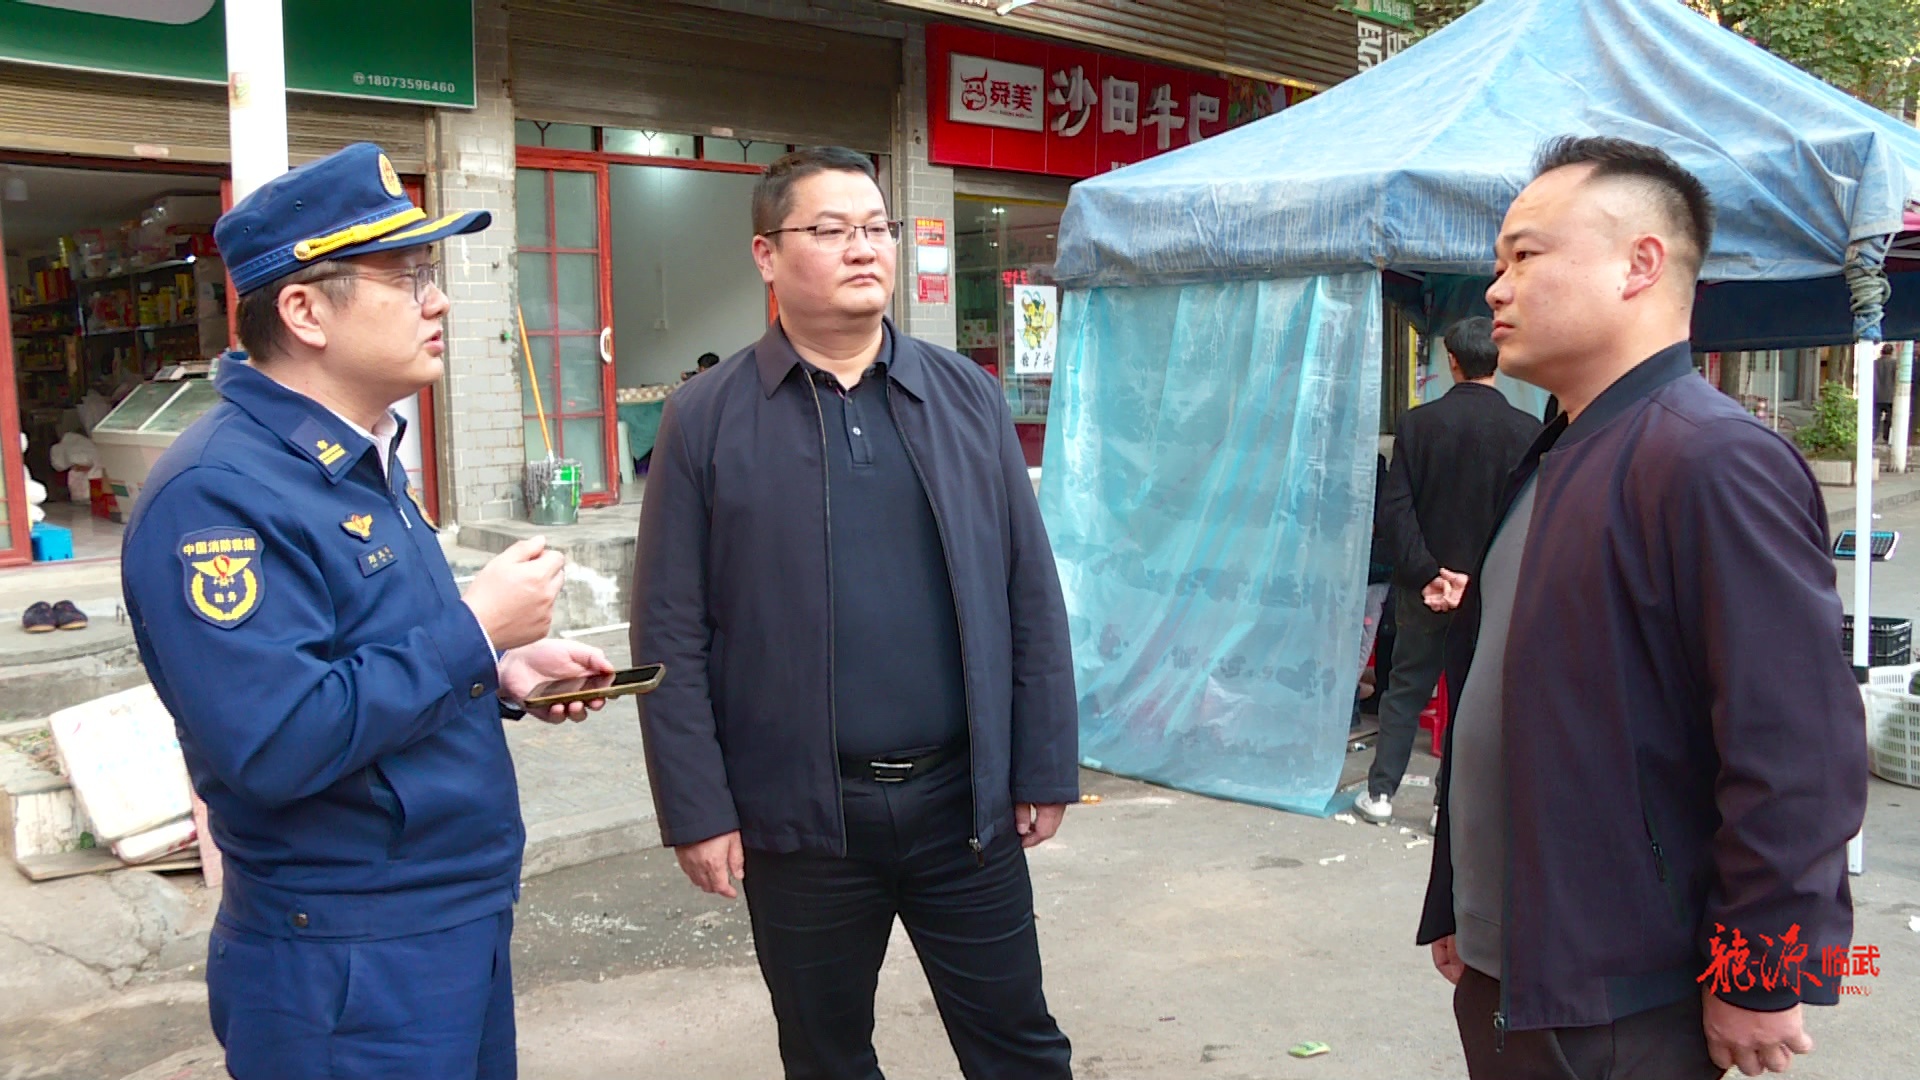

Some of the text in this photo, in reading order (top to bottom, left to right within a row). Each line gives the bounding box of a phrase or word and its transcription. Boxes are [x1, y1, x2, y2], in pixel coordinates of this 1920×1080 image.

[367, 73, 456, 94] 18073596460
[990, 80, 1033, 113] 舜美
[1048, 65, 1221, 150] 沙田牛巴
[182, 537, 257, 557] 中国消防救援
